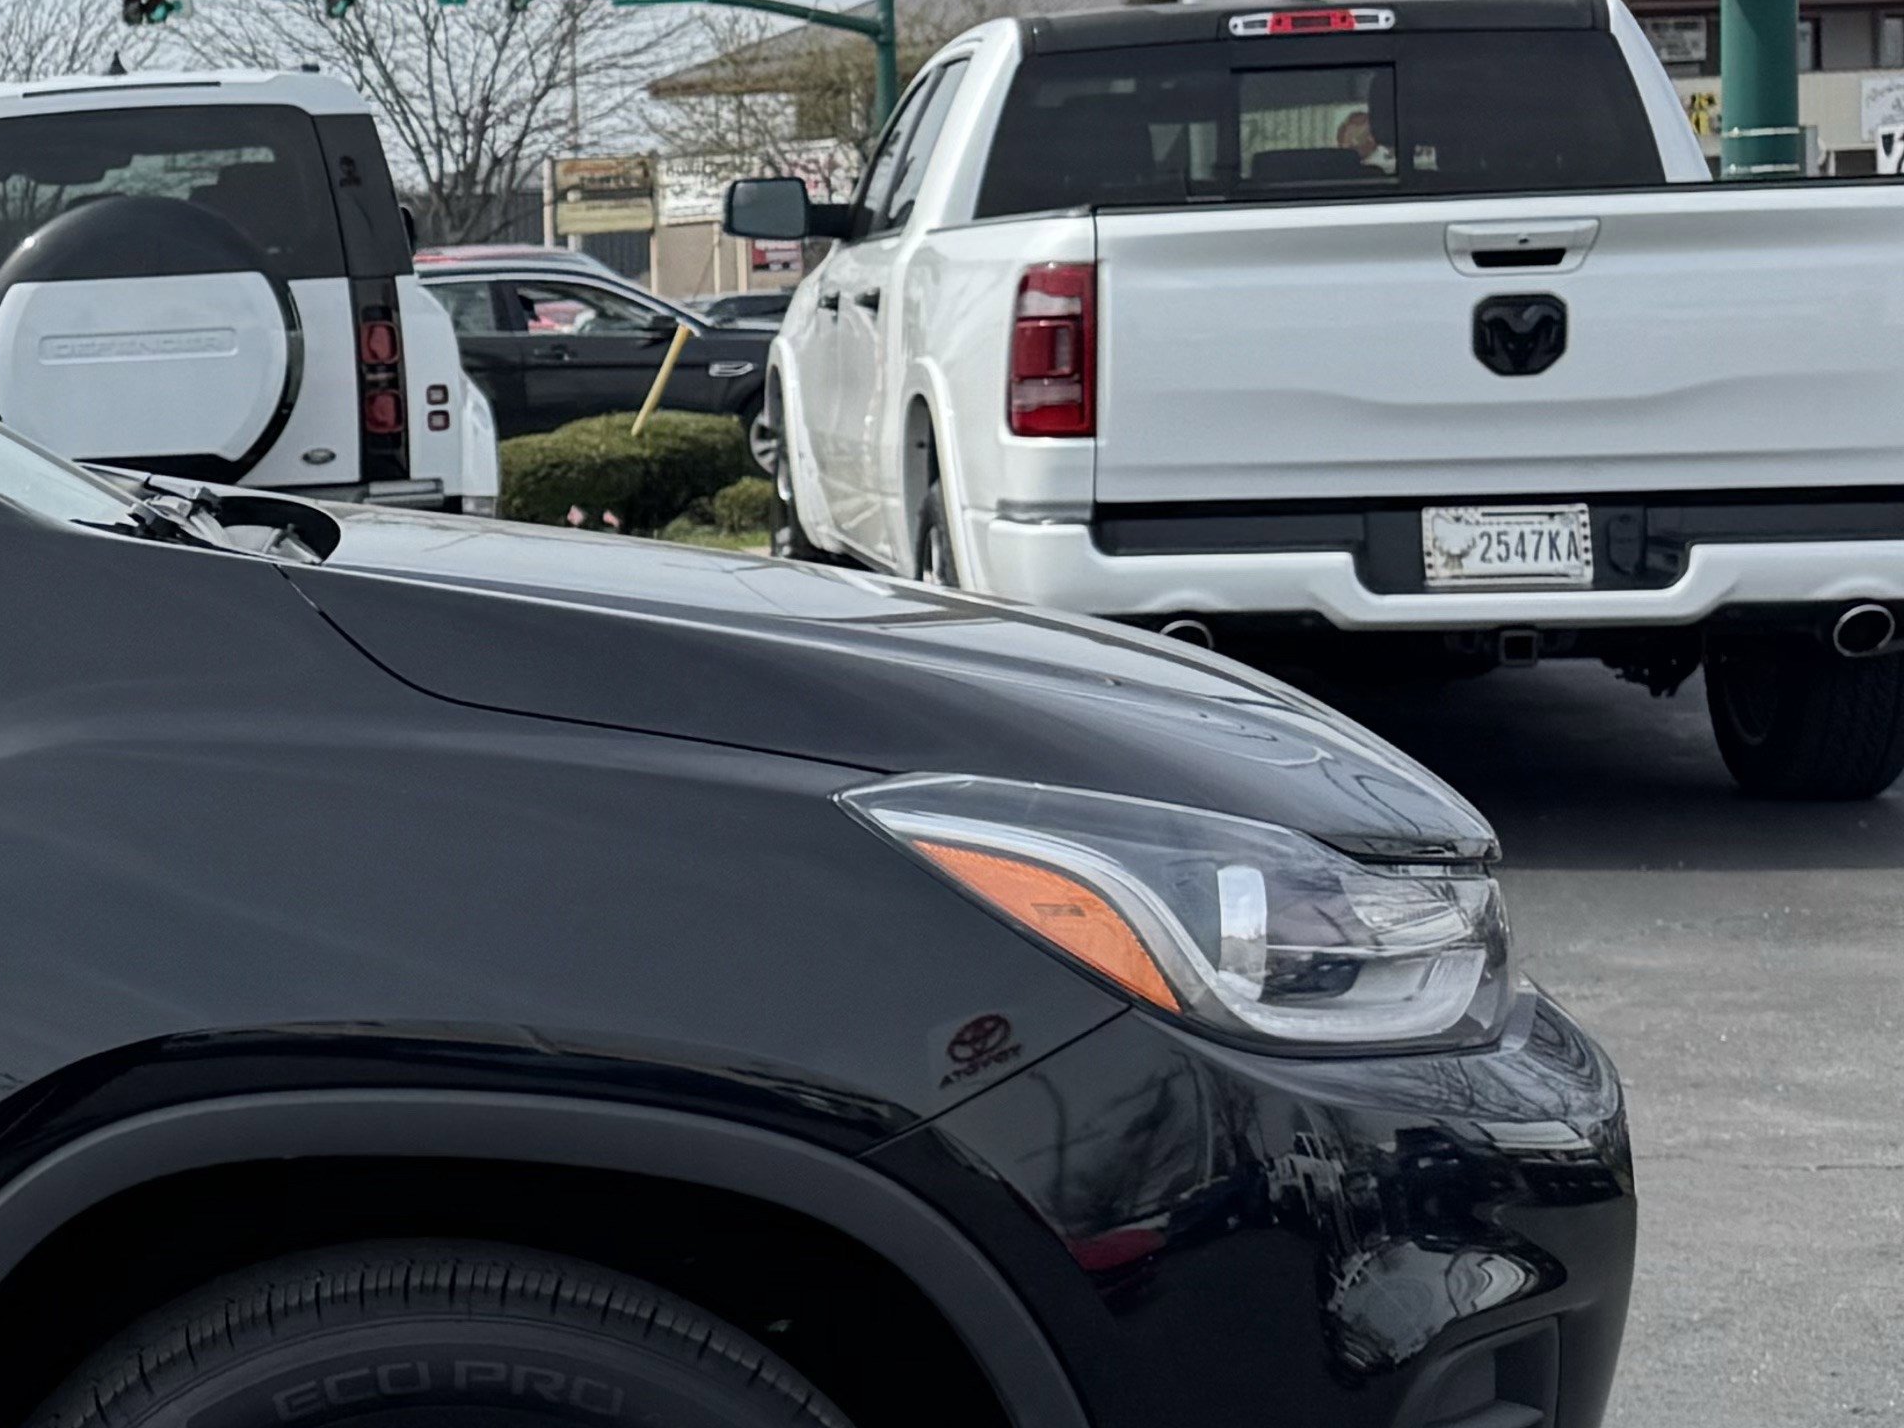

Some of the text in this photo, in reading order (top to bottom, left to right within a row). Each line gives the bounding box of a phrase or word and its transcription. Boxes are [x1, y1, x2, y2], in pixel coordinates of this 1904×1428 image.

[1479, 530, 1580, 564] 2547KA
[272, 1360, 625, 1422] ECO PRO
